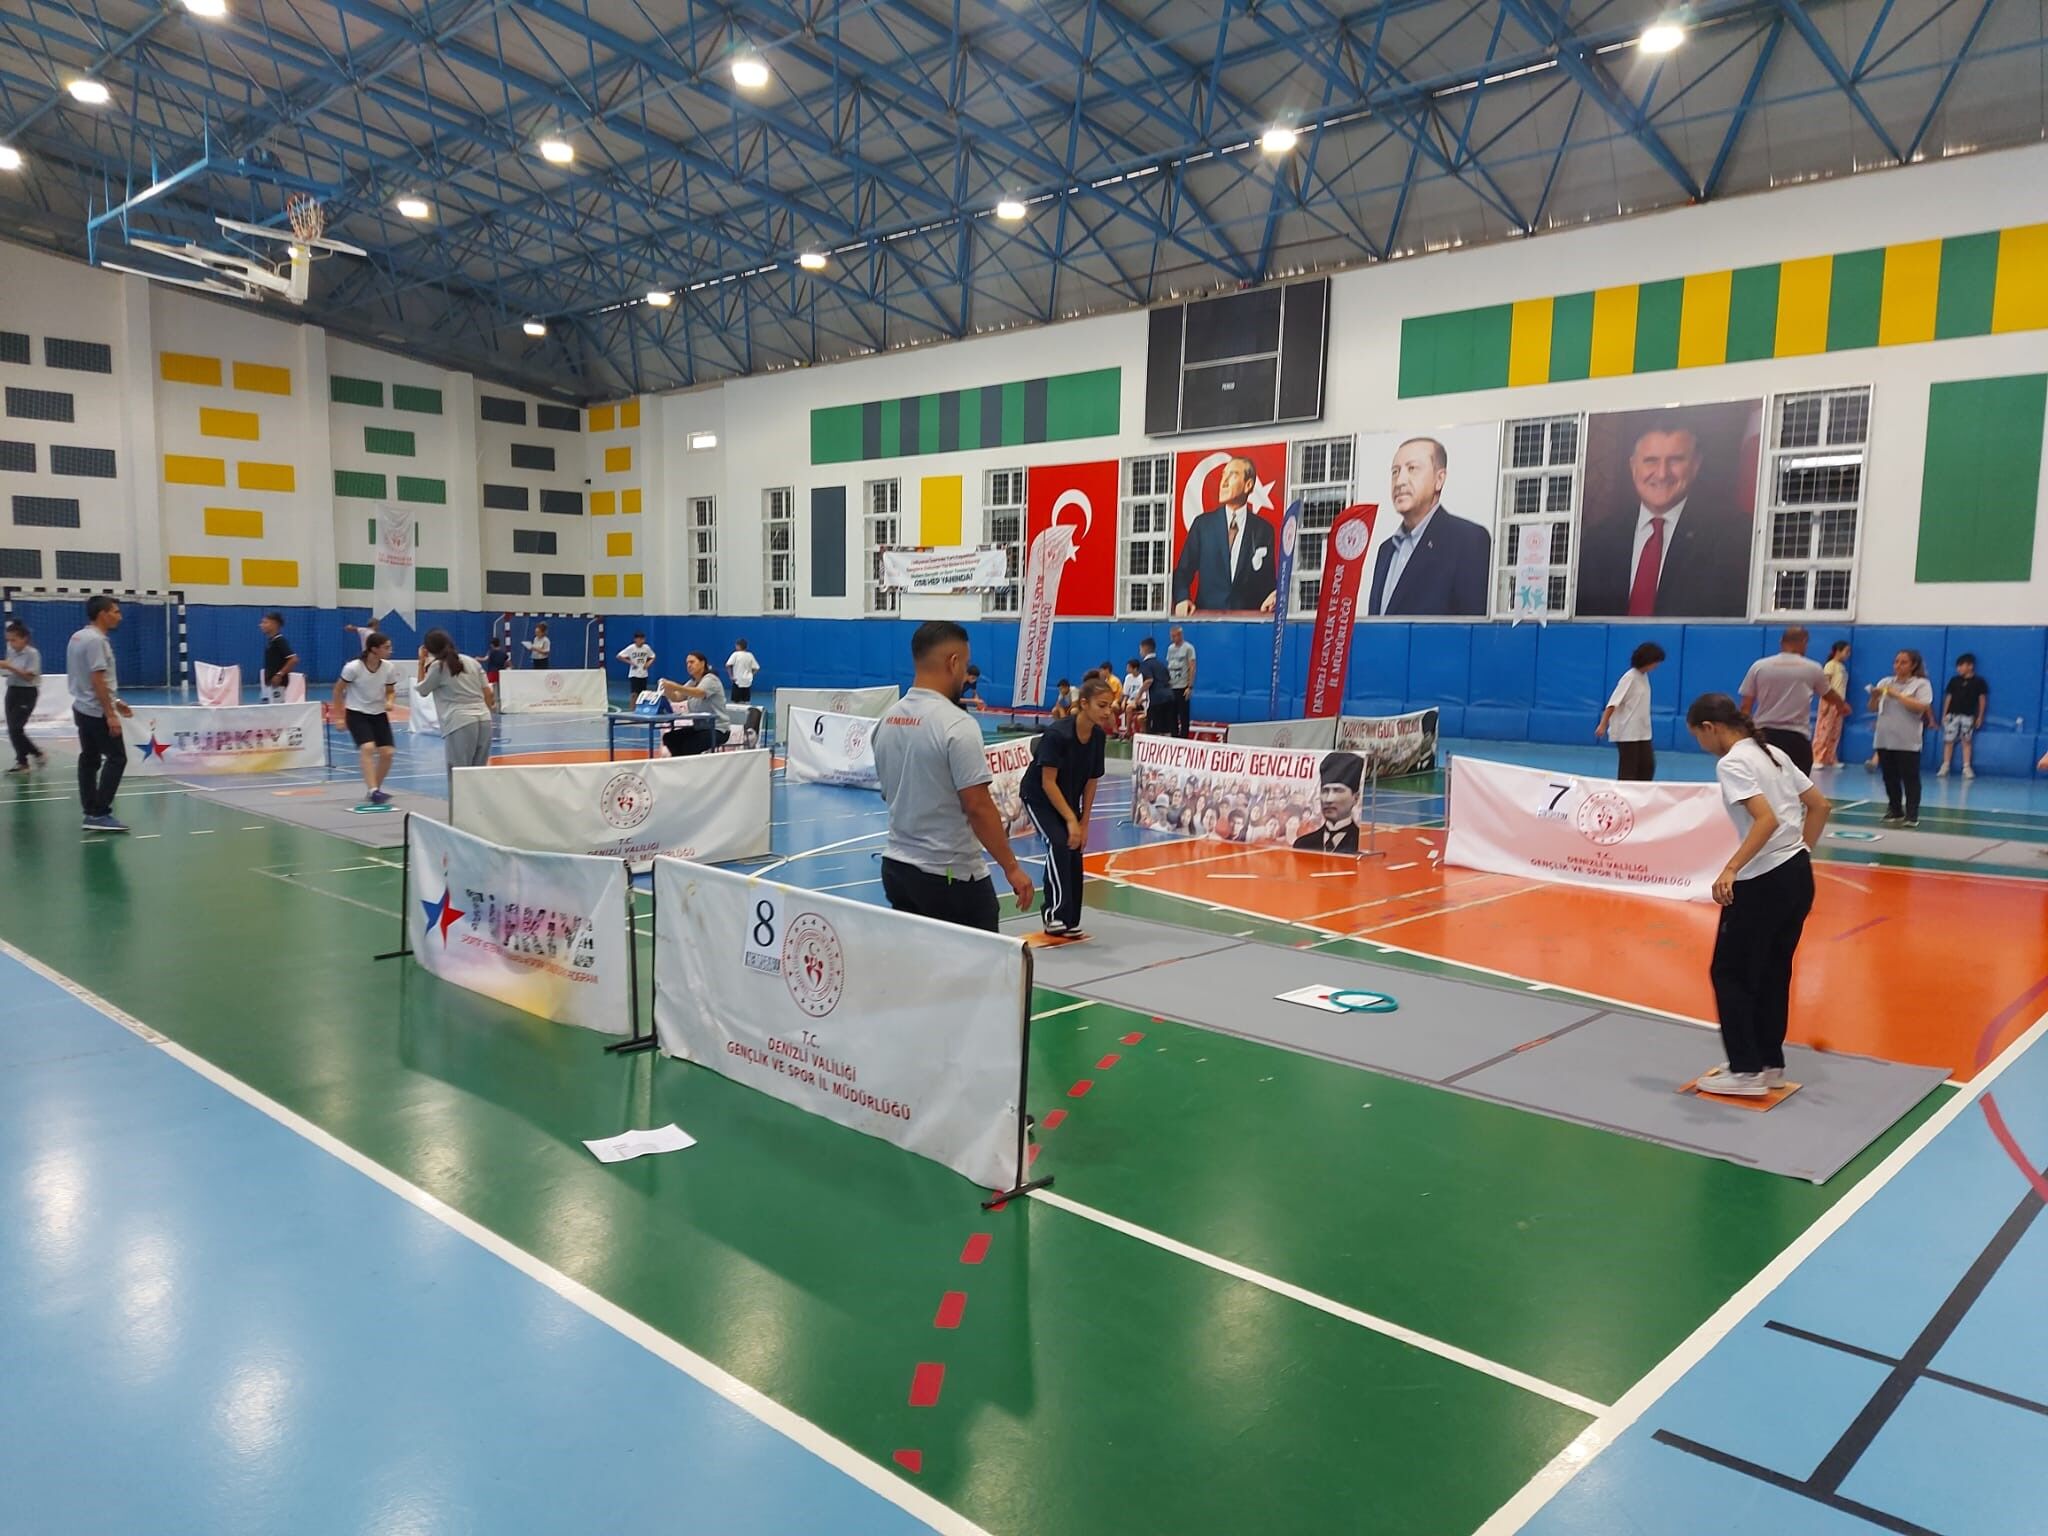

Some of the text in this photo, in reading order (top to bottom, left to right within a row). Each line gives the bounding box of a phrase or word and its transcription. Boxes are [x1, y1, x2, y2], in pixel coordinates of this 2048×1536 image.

[1312, 564, 1345, 714] DENİZLİ GENÇLİK VE SPOR
[1328, 597, 1352, 688] İL MÜDÜRLÜĞÜ
[814, 714, 825, 736] 6
[1136, 740, 1208, 770] TÜRKİYE'NİN
[1549, 783, 1571, 811] 7
[1530, 858, 1569, 871] GENÇLİK
[1572, 865, 1584, 873] VE
[1587, 868, 1612, 878] SPOR
[1627, 873, 1692, 888] MÜDÜRLÜĞÜ
[1567, 856, 1649, 873] DENİZLİ VALİLİĞİ
[754, 900, 775, 947] 8
[802, 1030, 820, 1048] T.C.
[768, 1037, 857, 1083] DENİZLİ VALİLİĞİ
[727, 1041, 911, 1120] GENÇLİK VE SPOR İL MÜDÜRLÜĞÜ
